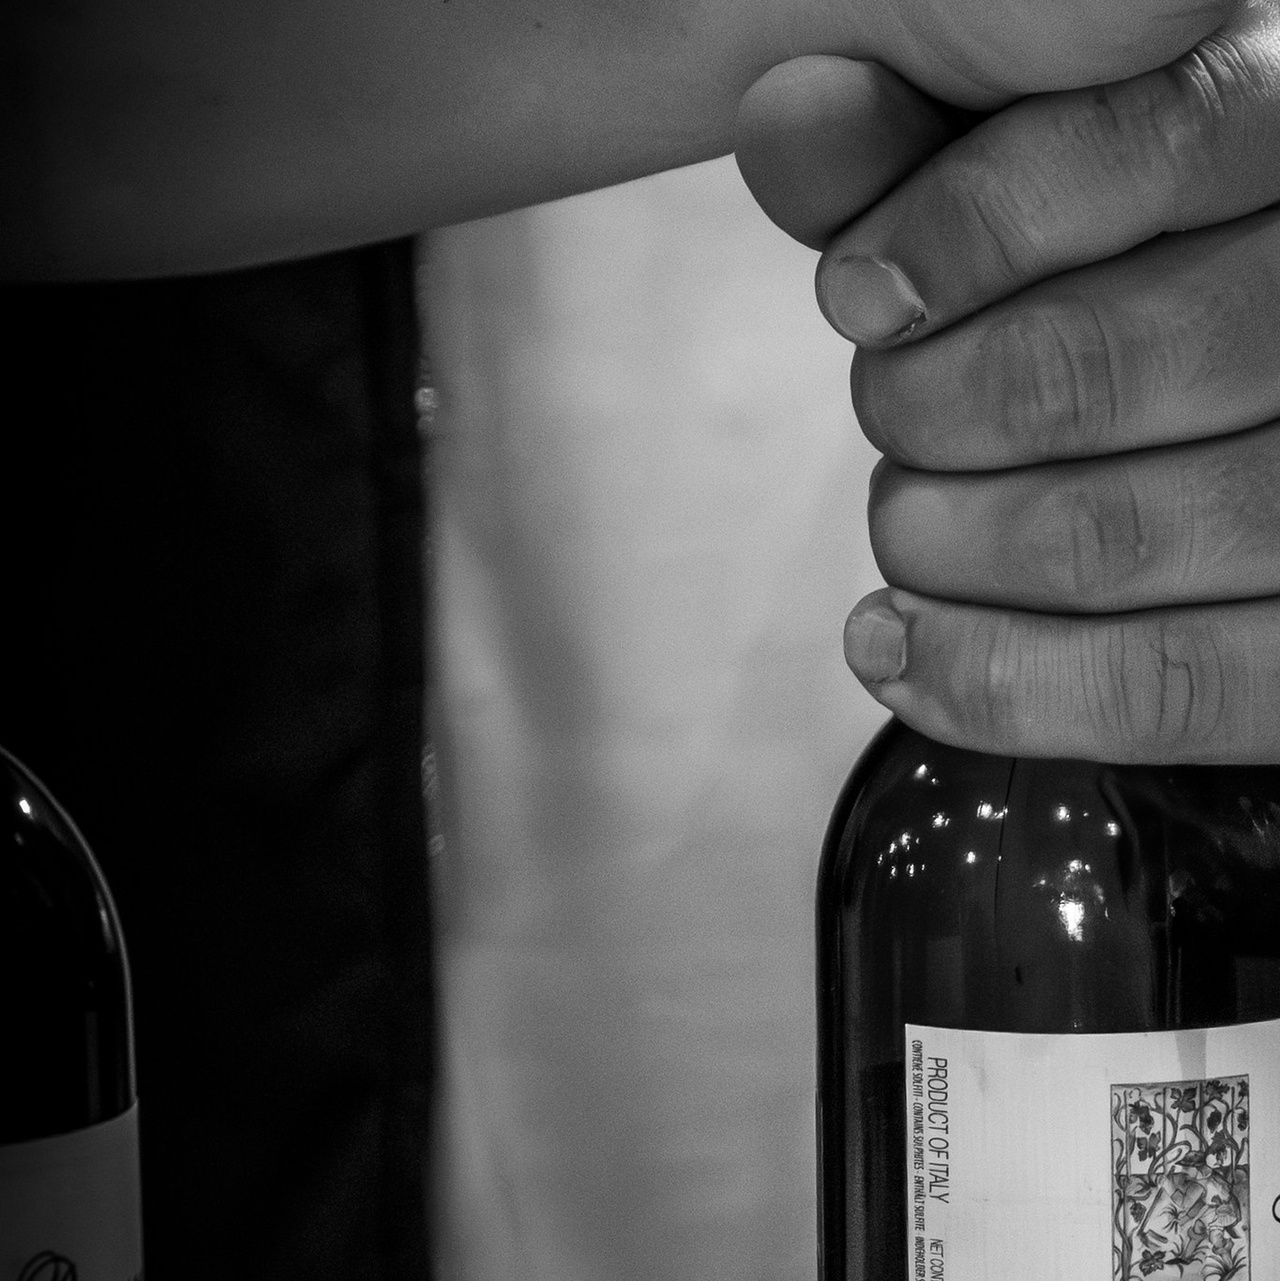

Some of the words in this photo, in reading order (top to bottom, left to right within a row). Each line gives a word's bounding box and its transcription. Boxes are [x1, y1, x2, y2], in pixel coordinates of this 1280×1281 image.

[927, 1057, 949, 1135] PRODUCT
[912, 1102, 925, 1134] CONTAINS
[928, 1137, 949, 1160] OF
[928, 1162, 950, 1204] ITALY
[929, 1238, 944, 1258] NET
